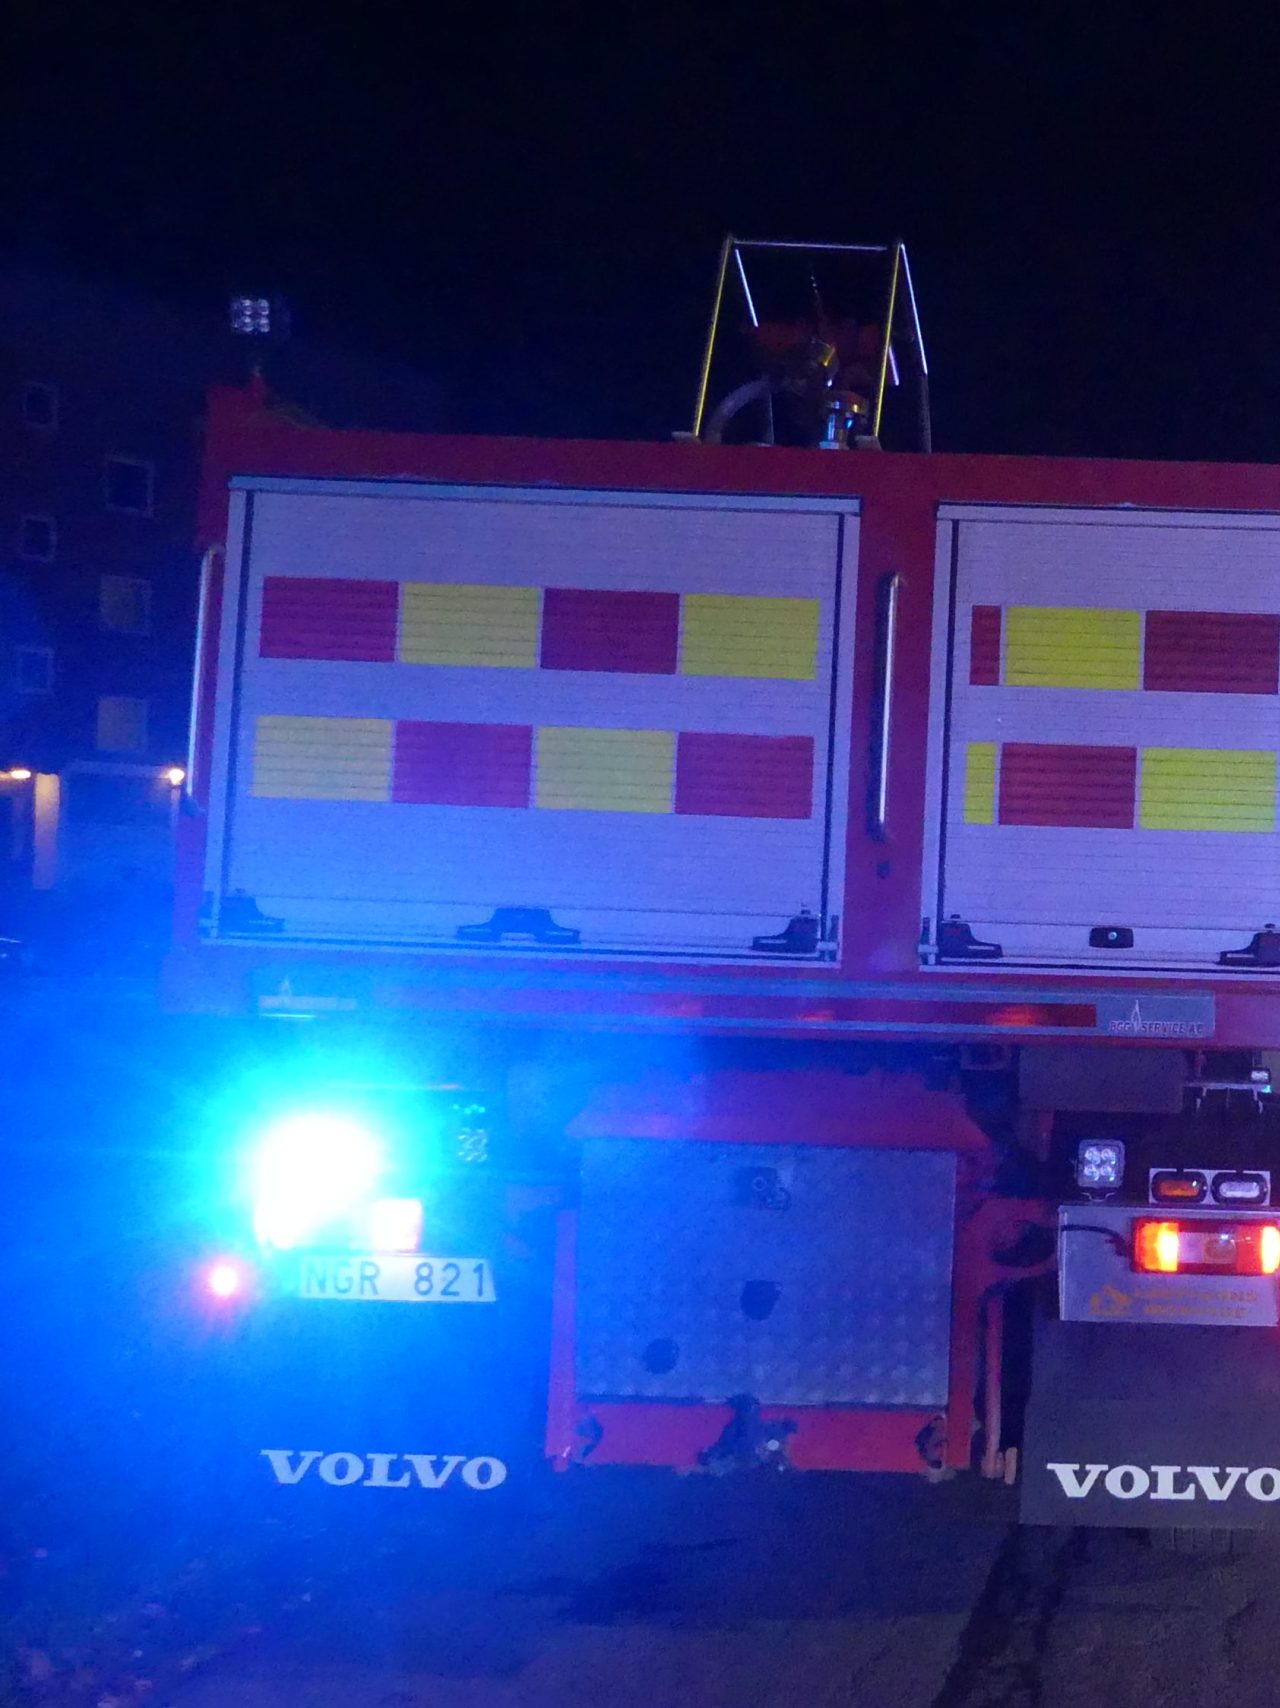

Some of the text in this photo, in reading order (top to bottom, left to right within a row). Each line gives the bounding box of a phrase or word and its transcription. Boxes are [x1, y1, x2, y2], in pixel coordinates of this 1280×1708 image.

[304, 1262, 485, 1297] NGR 821
[261, 1449, 507, 1490] VOLVO
